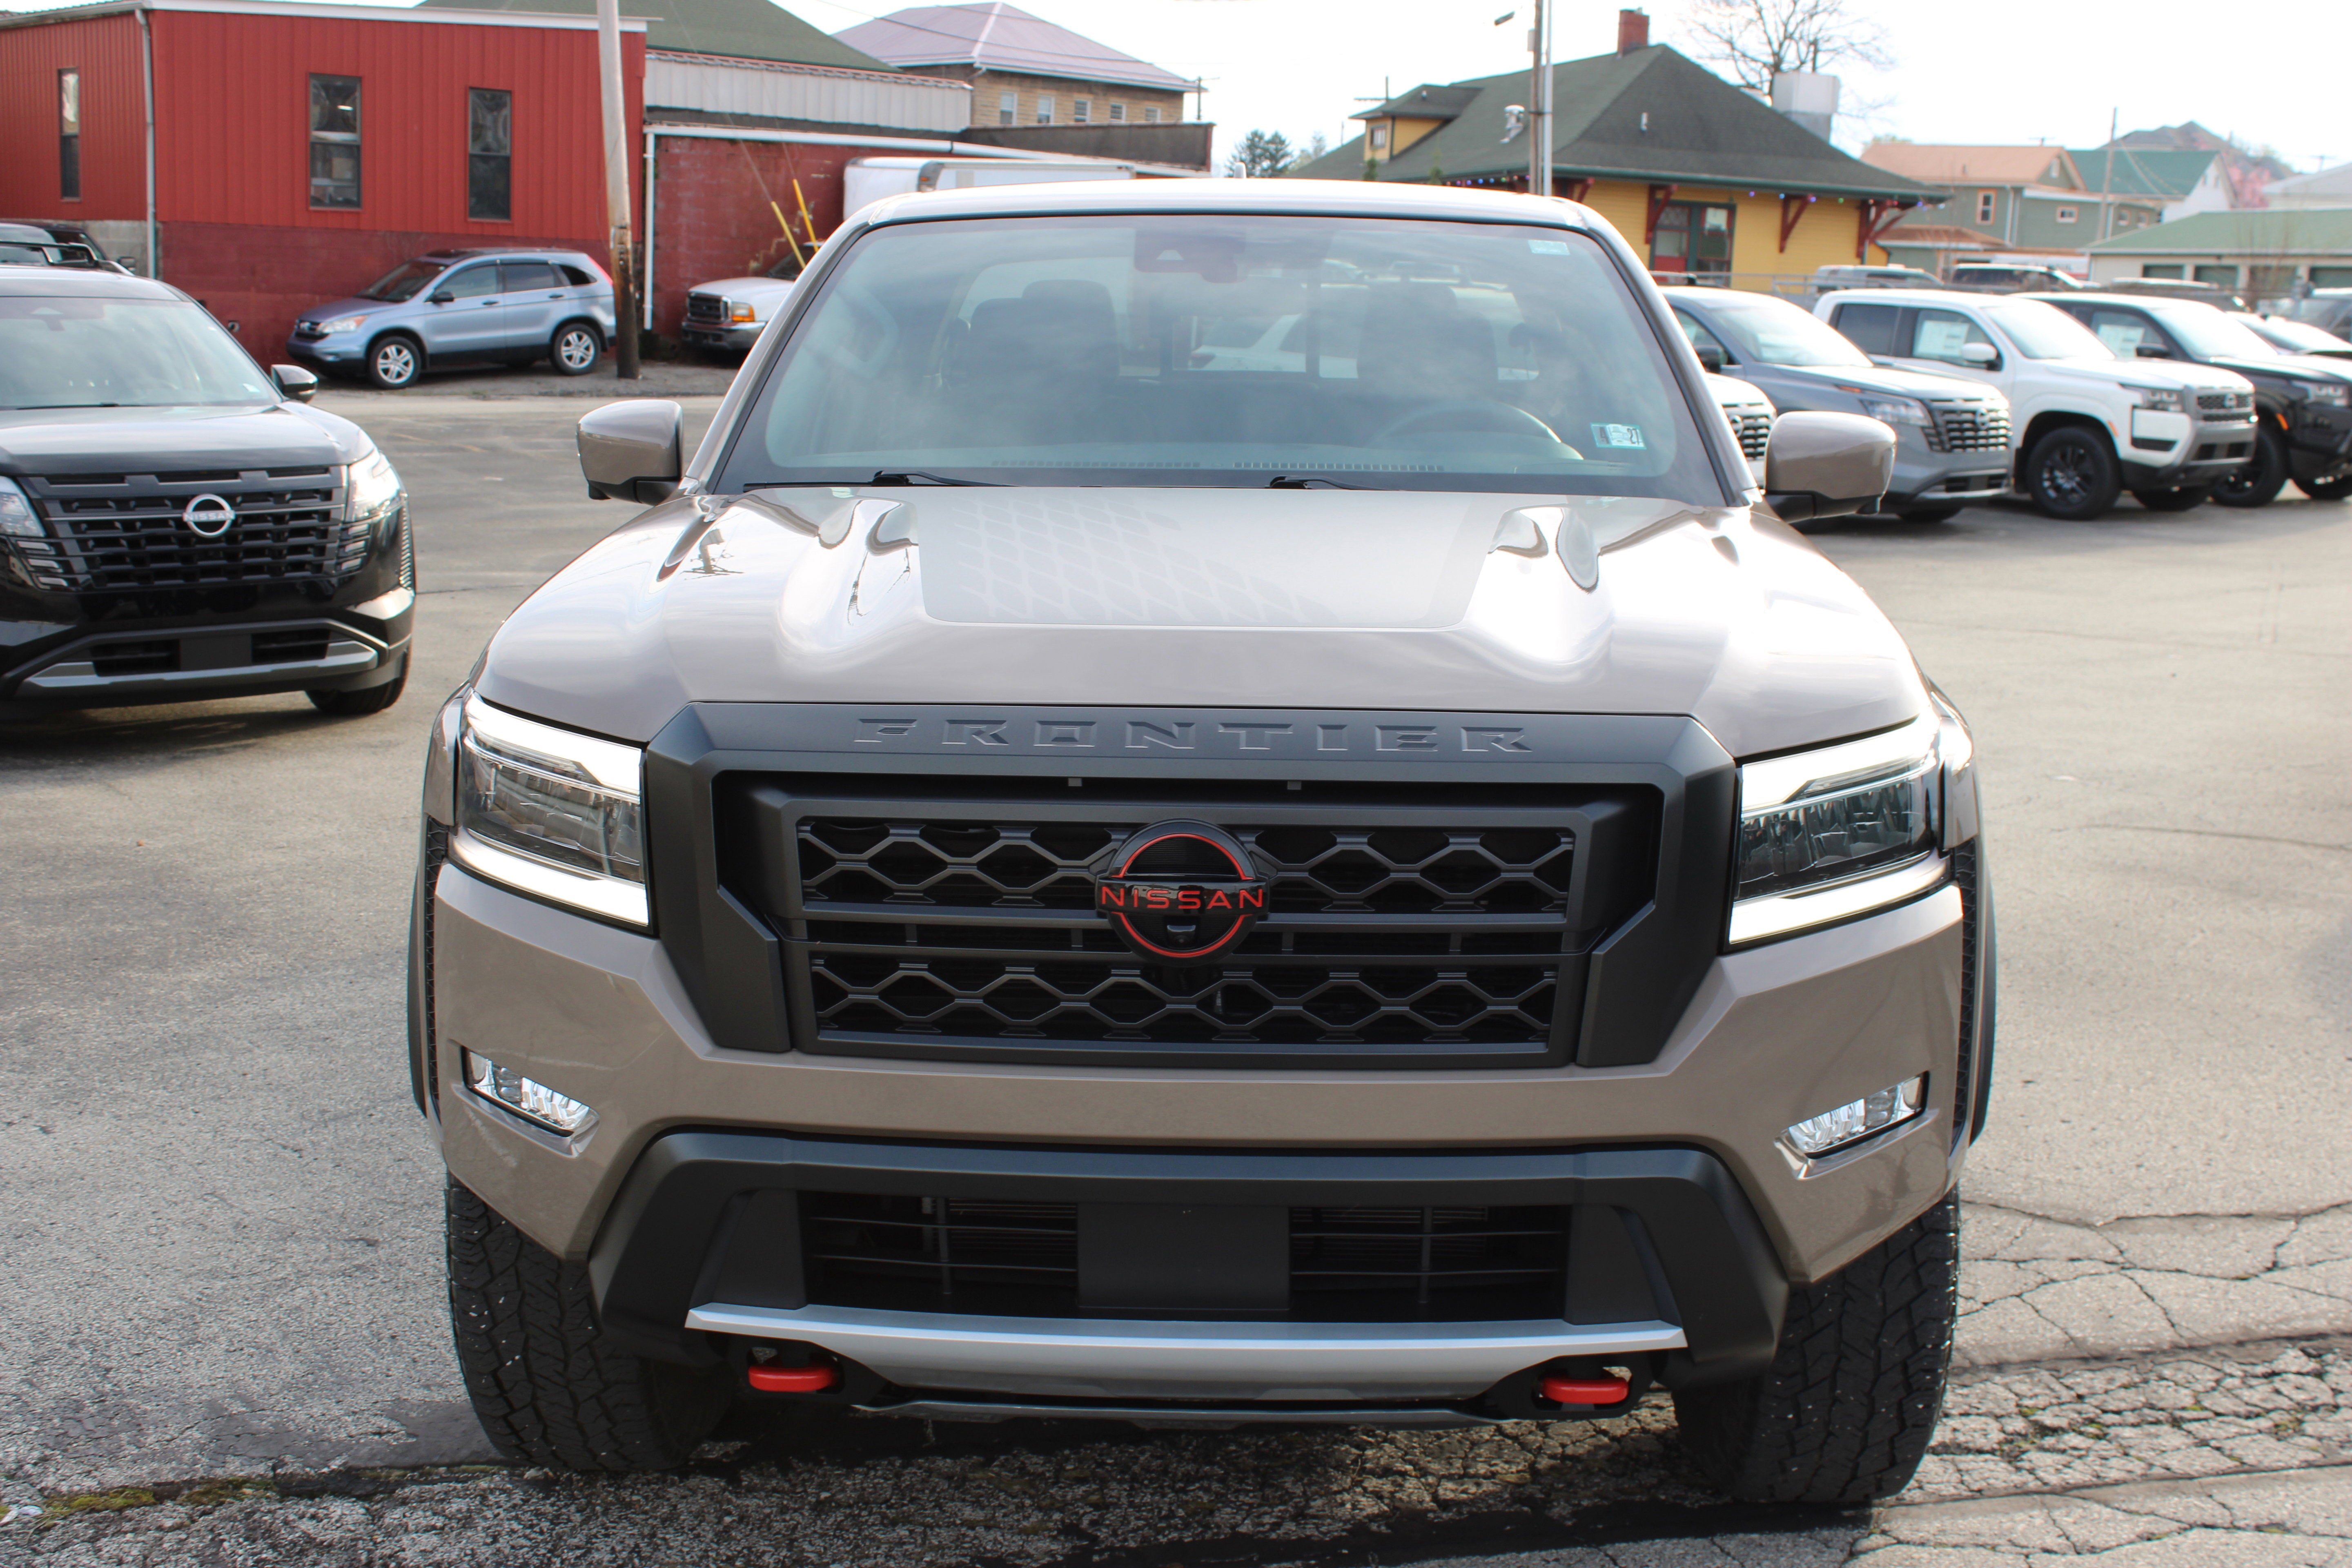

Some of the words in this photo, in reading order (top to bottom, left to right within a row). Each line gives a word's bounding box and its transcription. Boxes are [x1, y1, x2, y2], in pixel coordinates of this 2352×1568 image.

[185, 512, 234, 521] NISSAN
[854, 718, 1532, 752] FRONTIER
[1101, 886, 1263, 909] NISSAN
